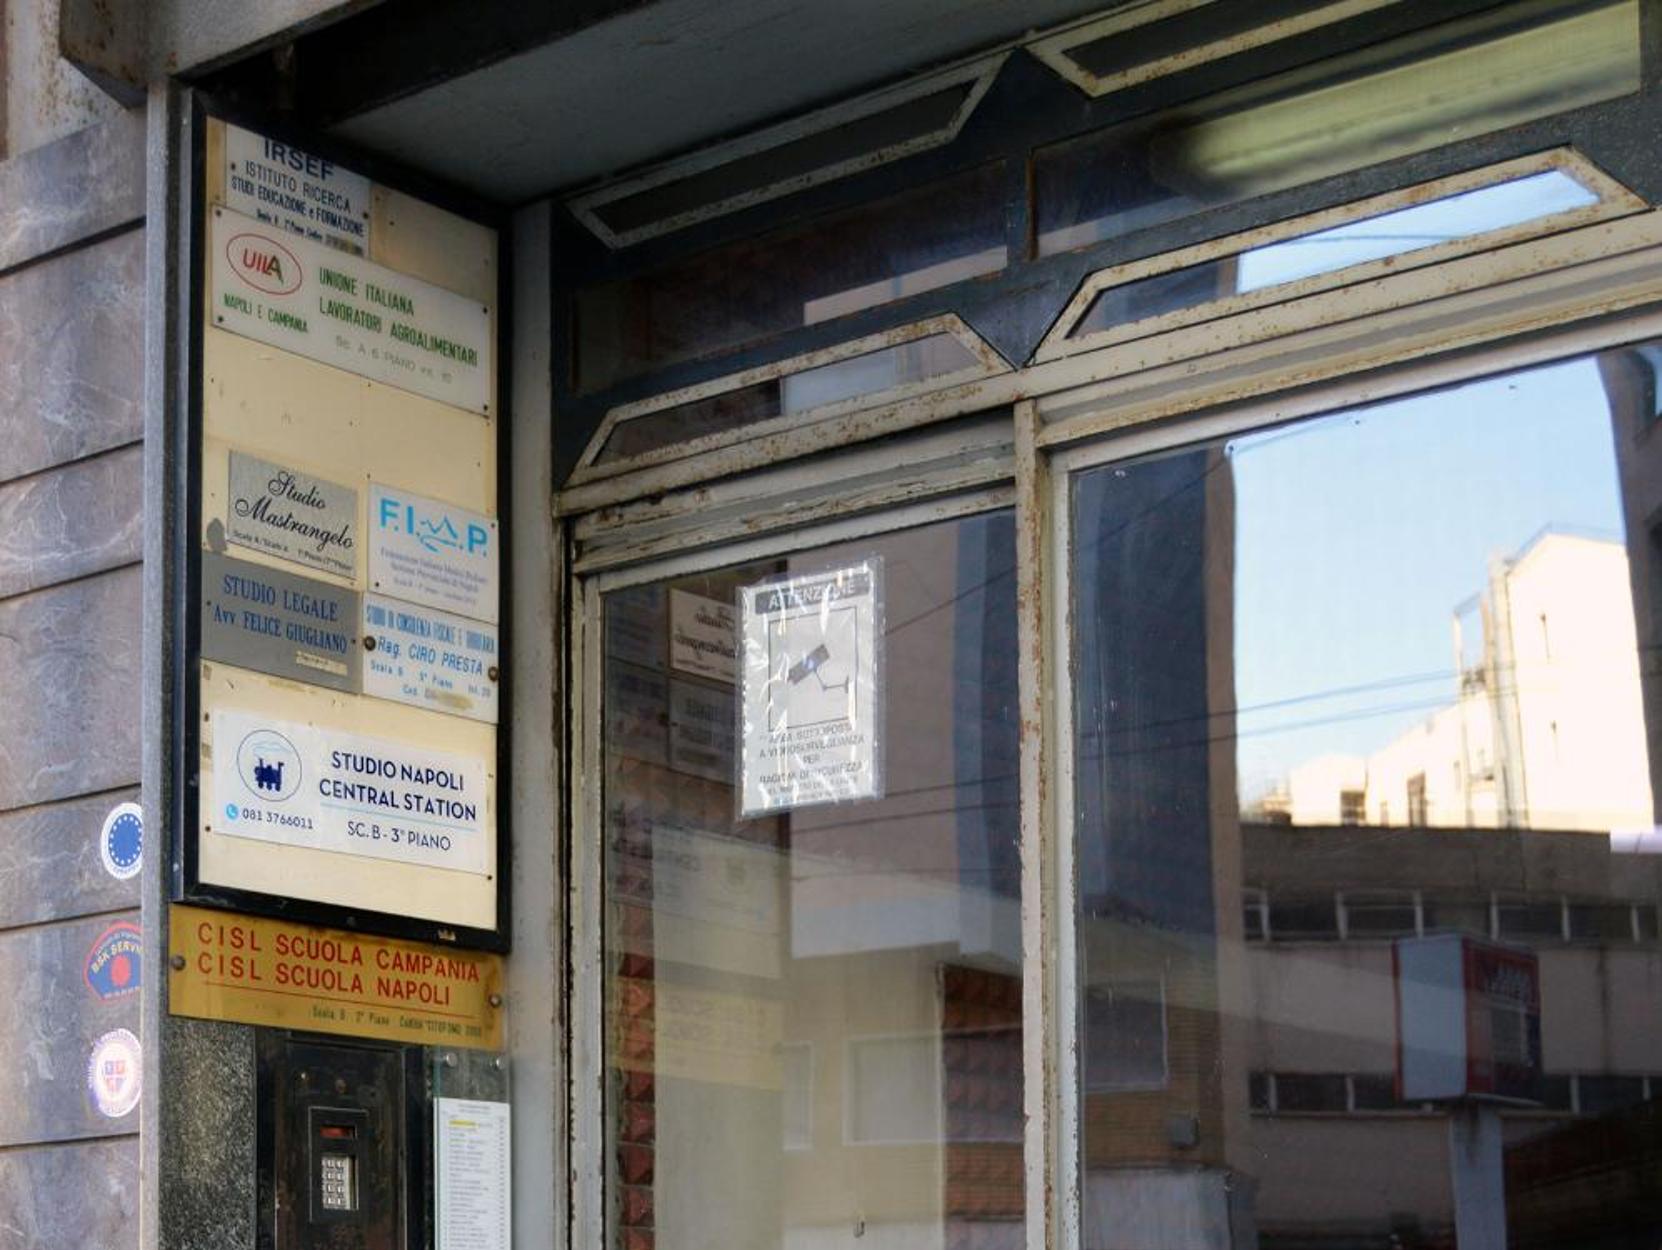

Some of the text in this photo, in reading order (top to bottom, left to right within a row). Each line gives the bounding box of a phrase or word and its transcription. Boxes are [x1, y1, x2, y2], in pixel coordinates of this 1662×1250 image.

[264, 138, 334, 180] IRSEF
[246, 160, 351, 213] ISTITUTO RICERCA
[258, 185, 306, 216] EDUCAZIONE
[316, 207, 364, 238] FORMAZIONE
[224, 293, 252, 315] NAPOLI
[268, 308, 308, 333] CAMPANIA
[319, 267, 414, 317] UNIONE ITALIANA
[320, 296, 478, 367] LAVORATORI AGROALIMENTARI
[268, 471, 326, 510] Studio
[235, 495, 353, 552] Mastrangelo
[223, 574, 276, 606] STUDIO
[284, 590, 338, 622] LEGALE
[768, 581, 856, 609] ATTENZONE
[243, 611, 281, 637] FELICE
[286, 622, 348, 654] GIUGLIANO
[408, 643, 436, 665] CIRO
[441, 651, 483, 676] PRESTA
[332, 751, 464, 791] STUDIO NAPOLI
[243, 809, 313, 829] 081 3766011
[319, 779, 476, 821] CENTRAL STATION
[372, 826, 380, 840] B
[408, 832, 450, 851] PIANO
[198, 922, 479, 982] CISL SCUOLA CAMPANIA
[198, 952, 449, 1006] CISL SCUOLA NAPOLI
